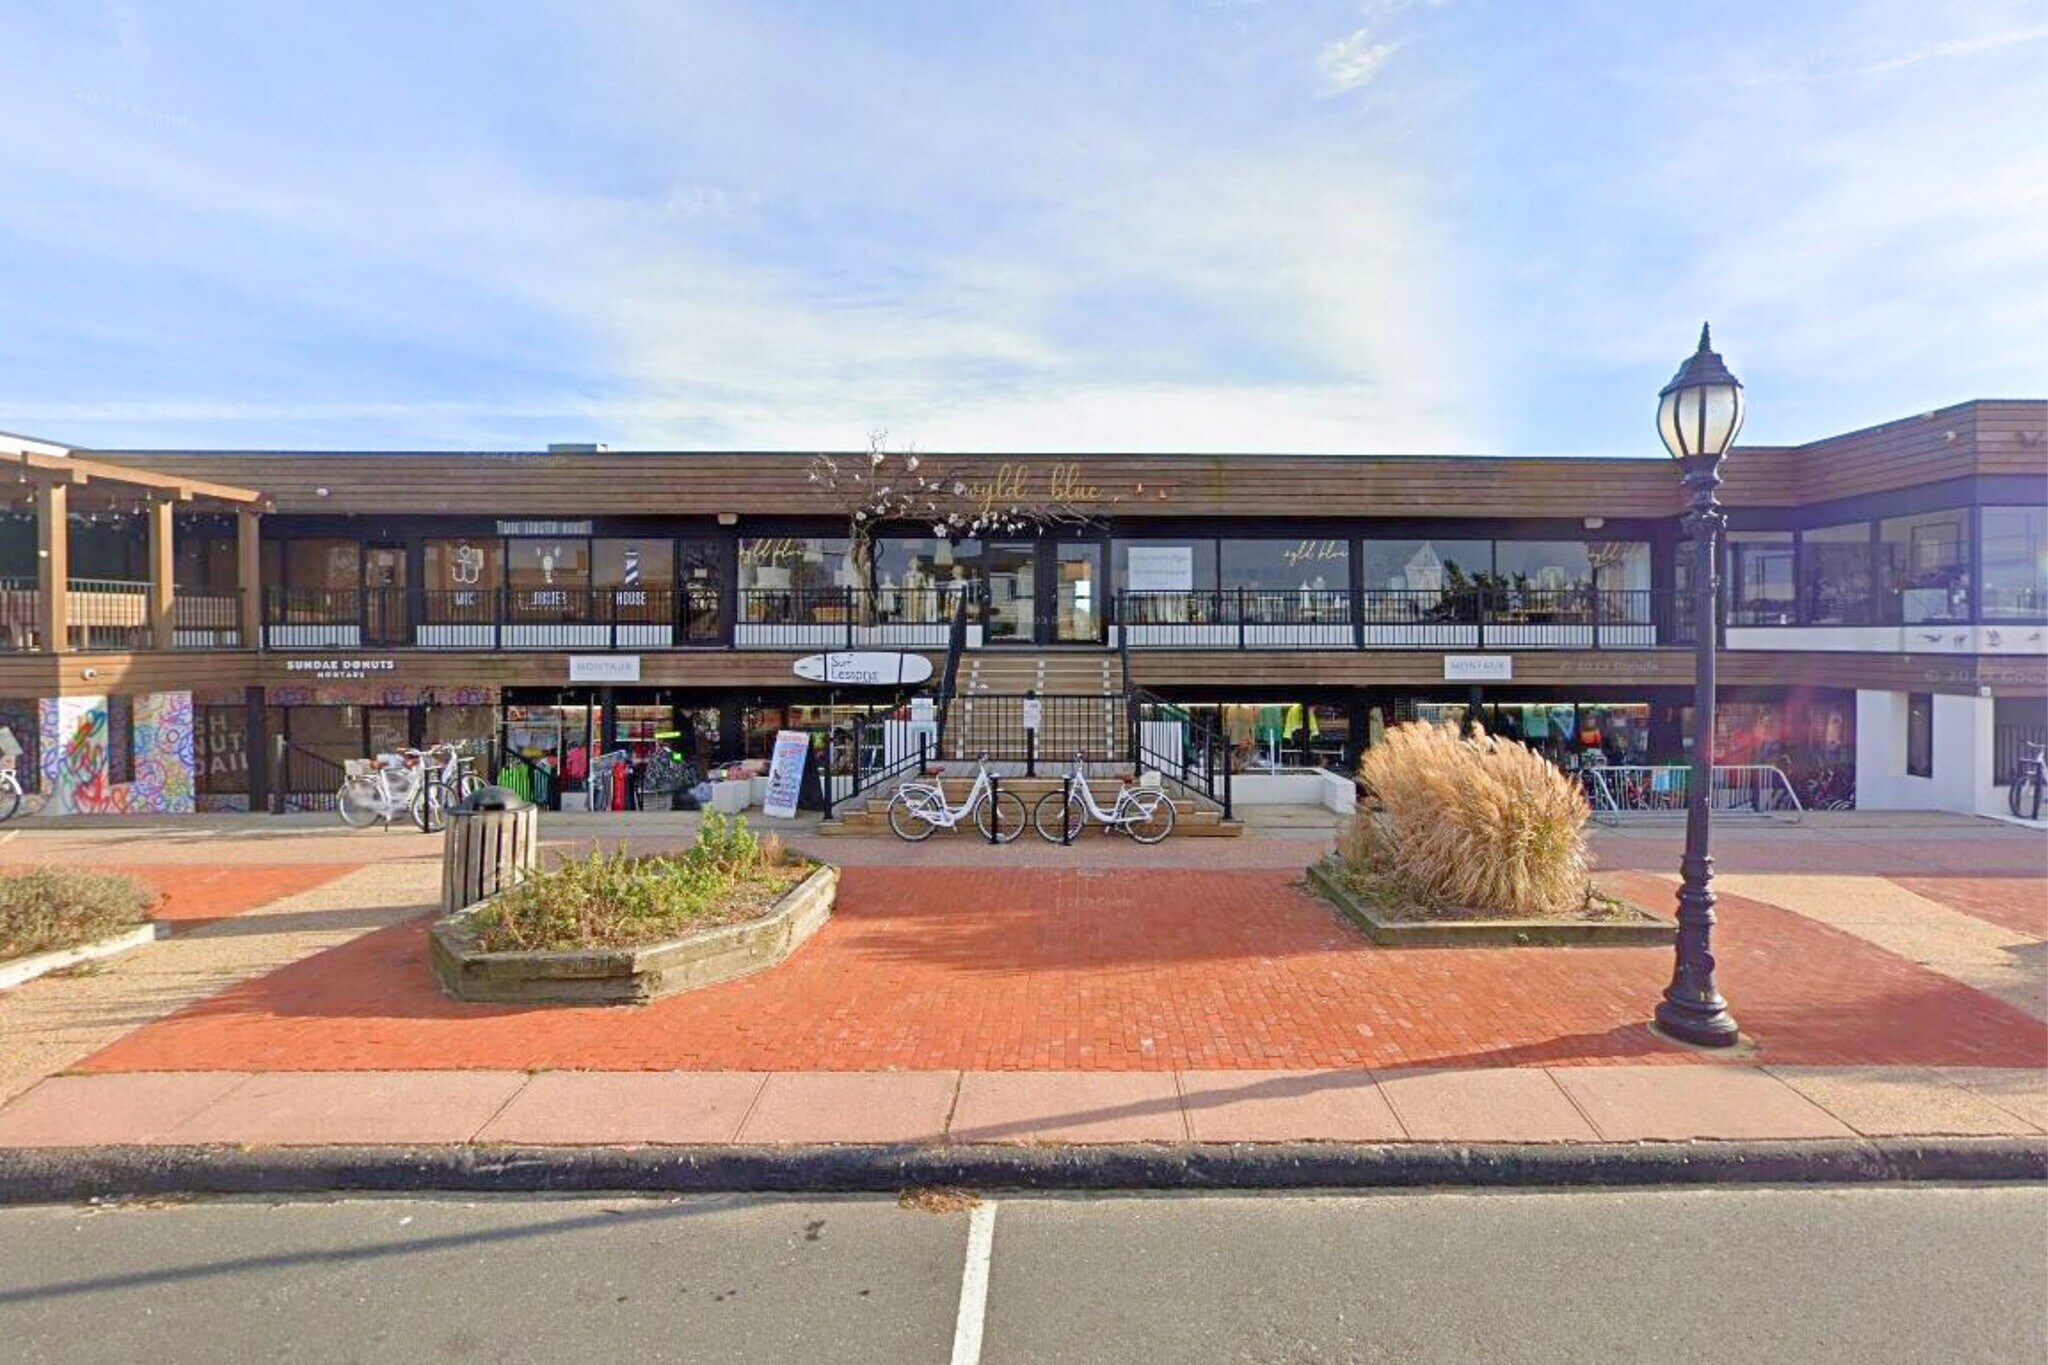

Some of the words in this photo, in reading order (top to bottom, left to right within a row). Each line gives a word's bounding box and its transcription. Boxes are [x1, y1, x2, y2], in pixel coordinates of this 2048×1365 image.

[963, 464, 1027, 513] wyld
[1050, 464, 1103, 501] blue
[615, 591, 646, 607] HOUSE
[286, 660, 339, 671] SUNDAE
[342, 660, 395, 670] DONUTS
[831, 669, 878, 681] Lessons
